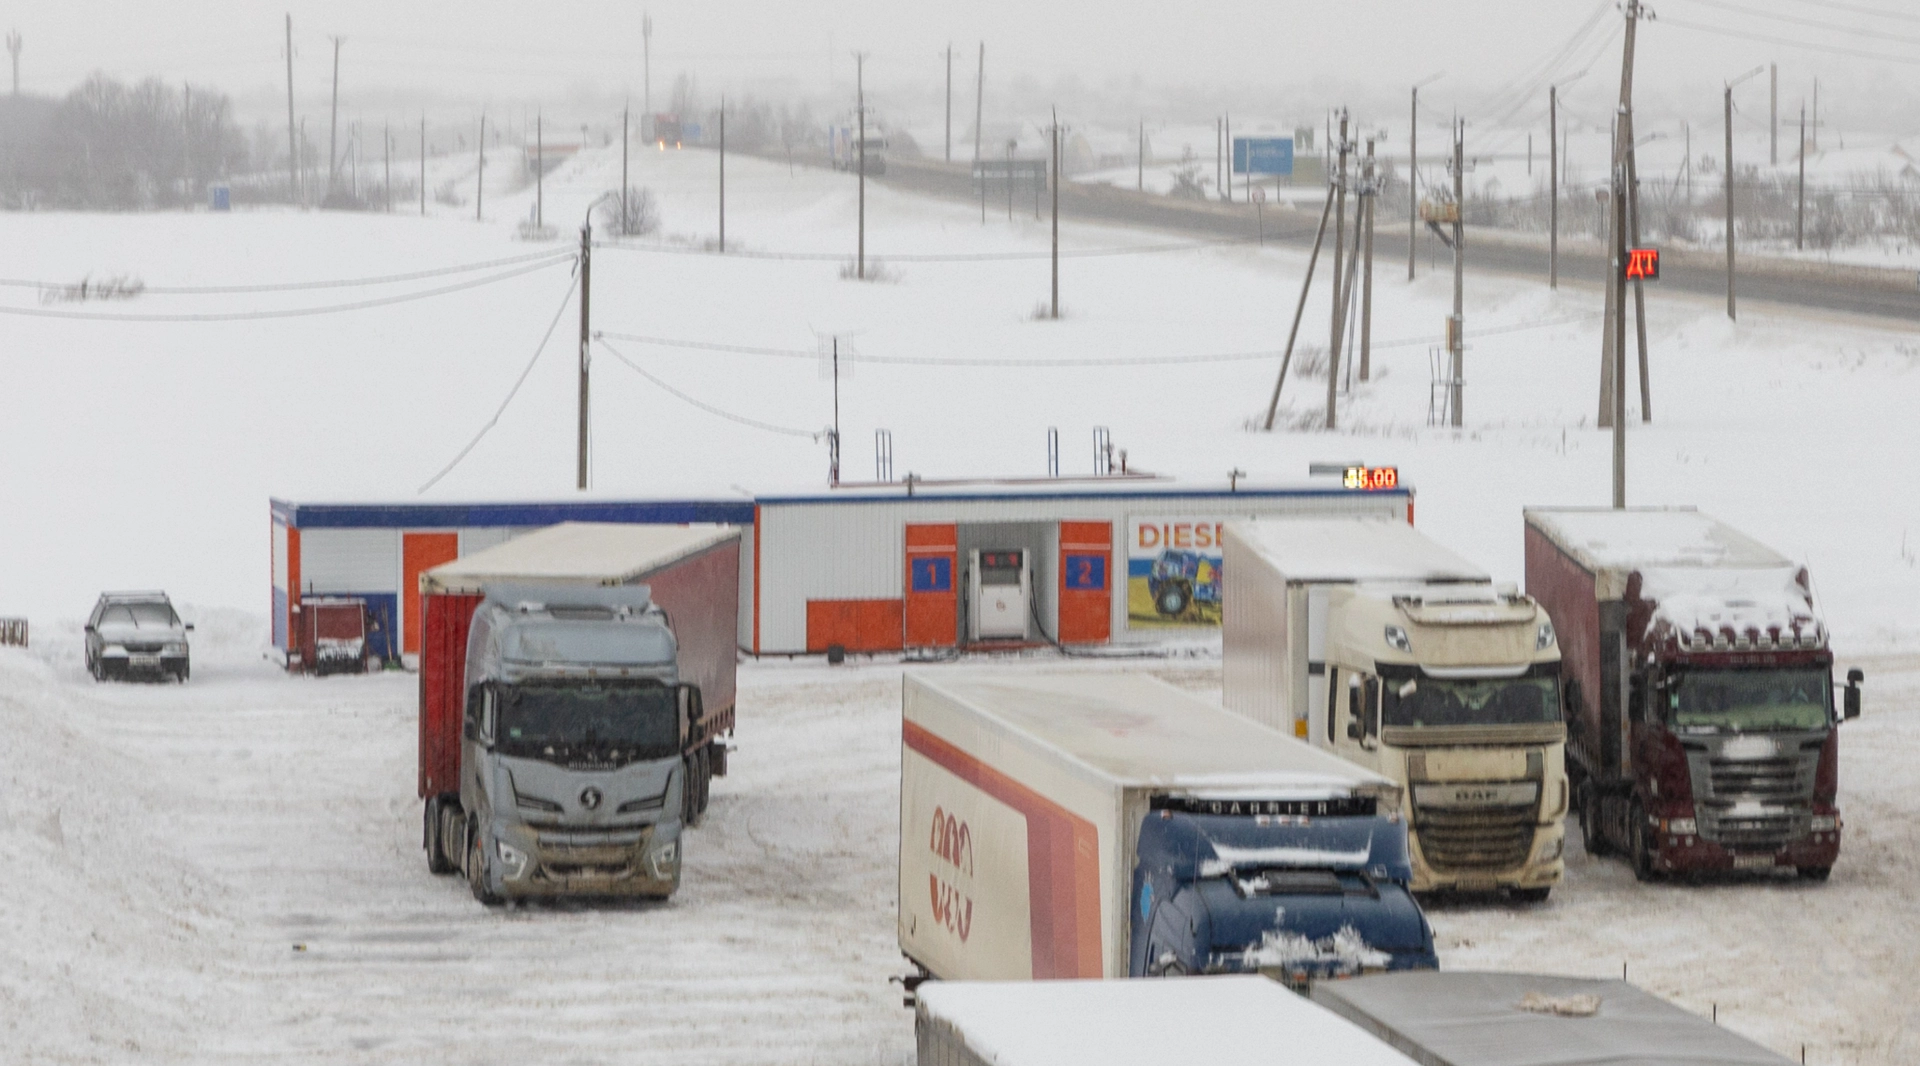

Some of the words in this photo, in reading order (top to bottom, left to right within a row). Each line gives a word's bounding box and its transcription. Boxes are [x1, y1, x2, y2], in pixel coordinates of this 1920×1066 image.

[1627, 249, 1657, 280] ДТ
[927, 563, 936, 585] 1
[1079, 560, 1092, 584] 2
